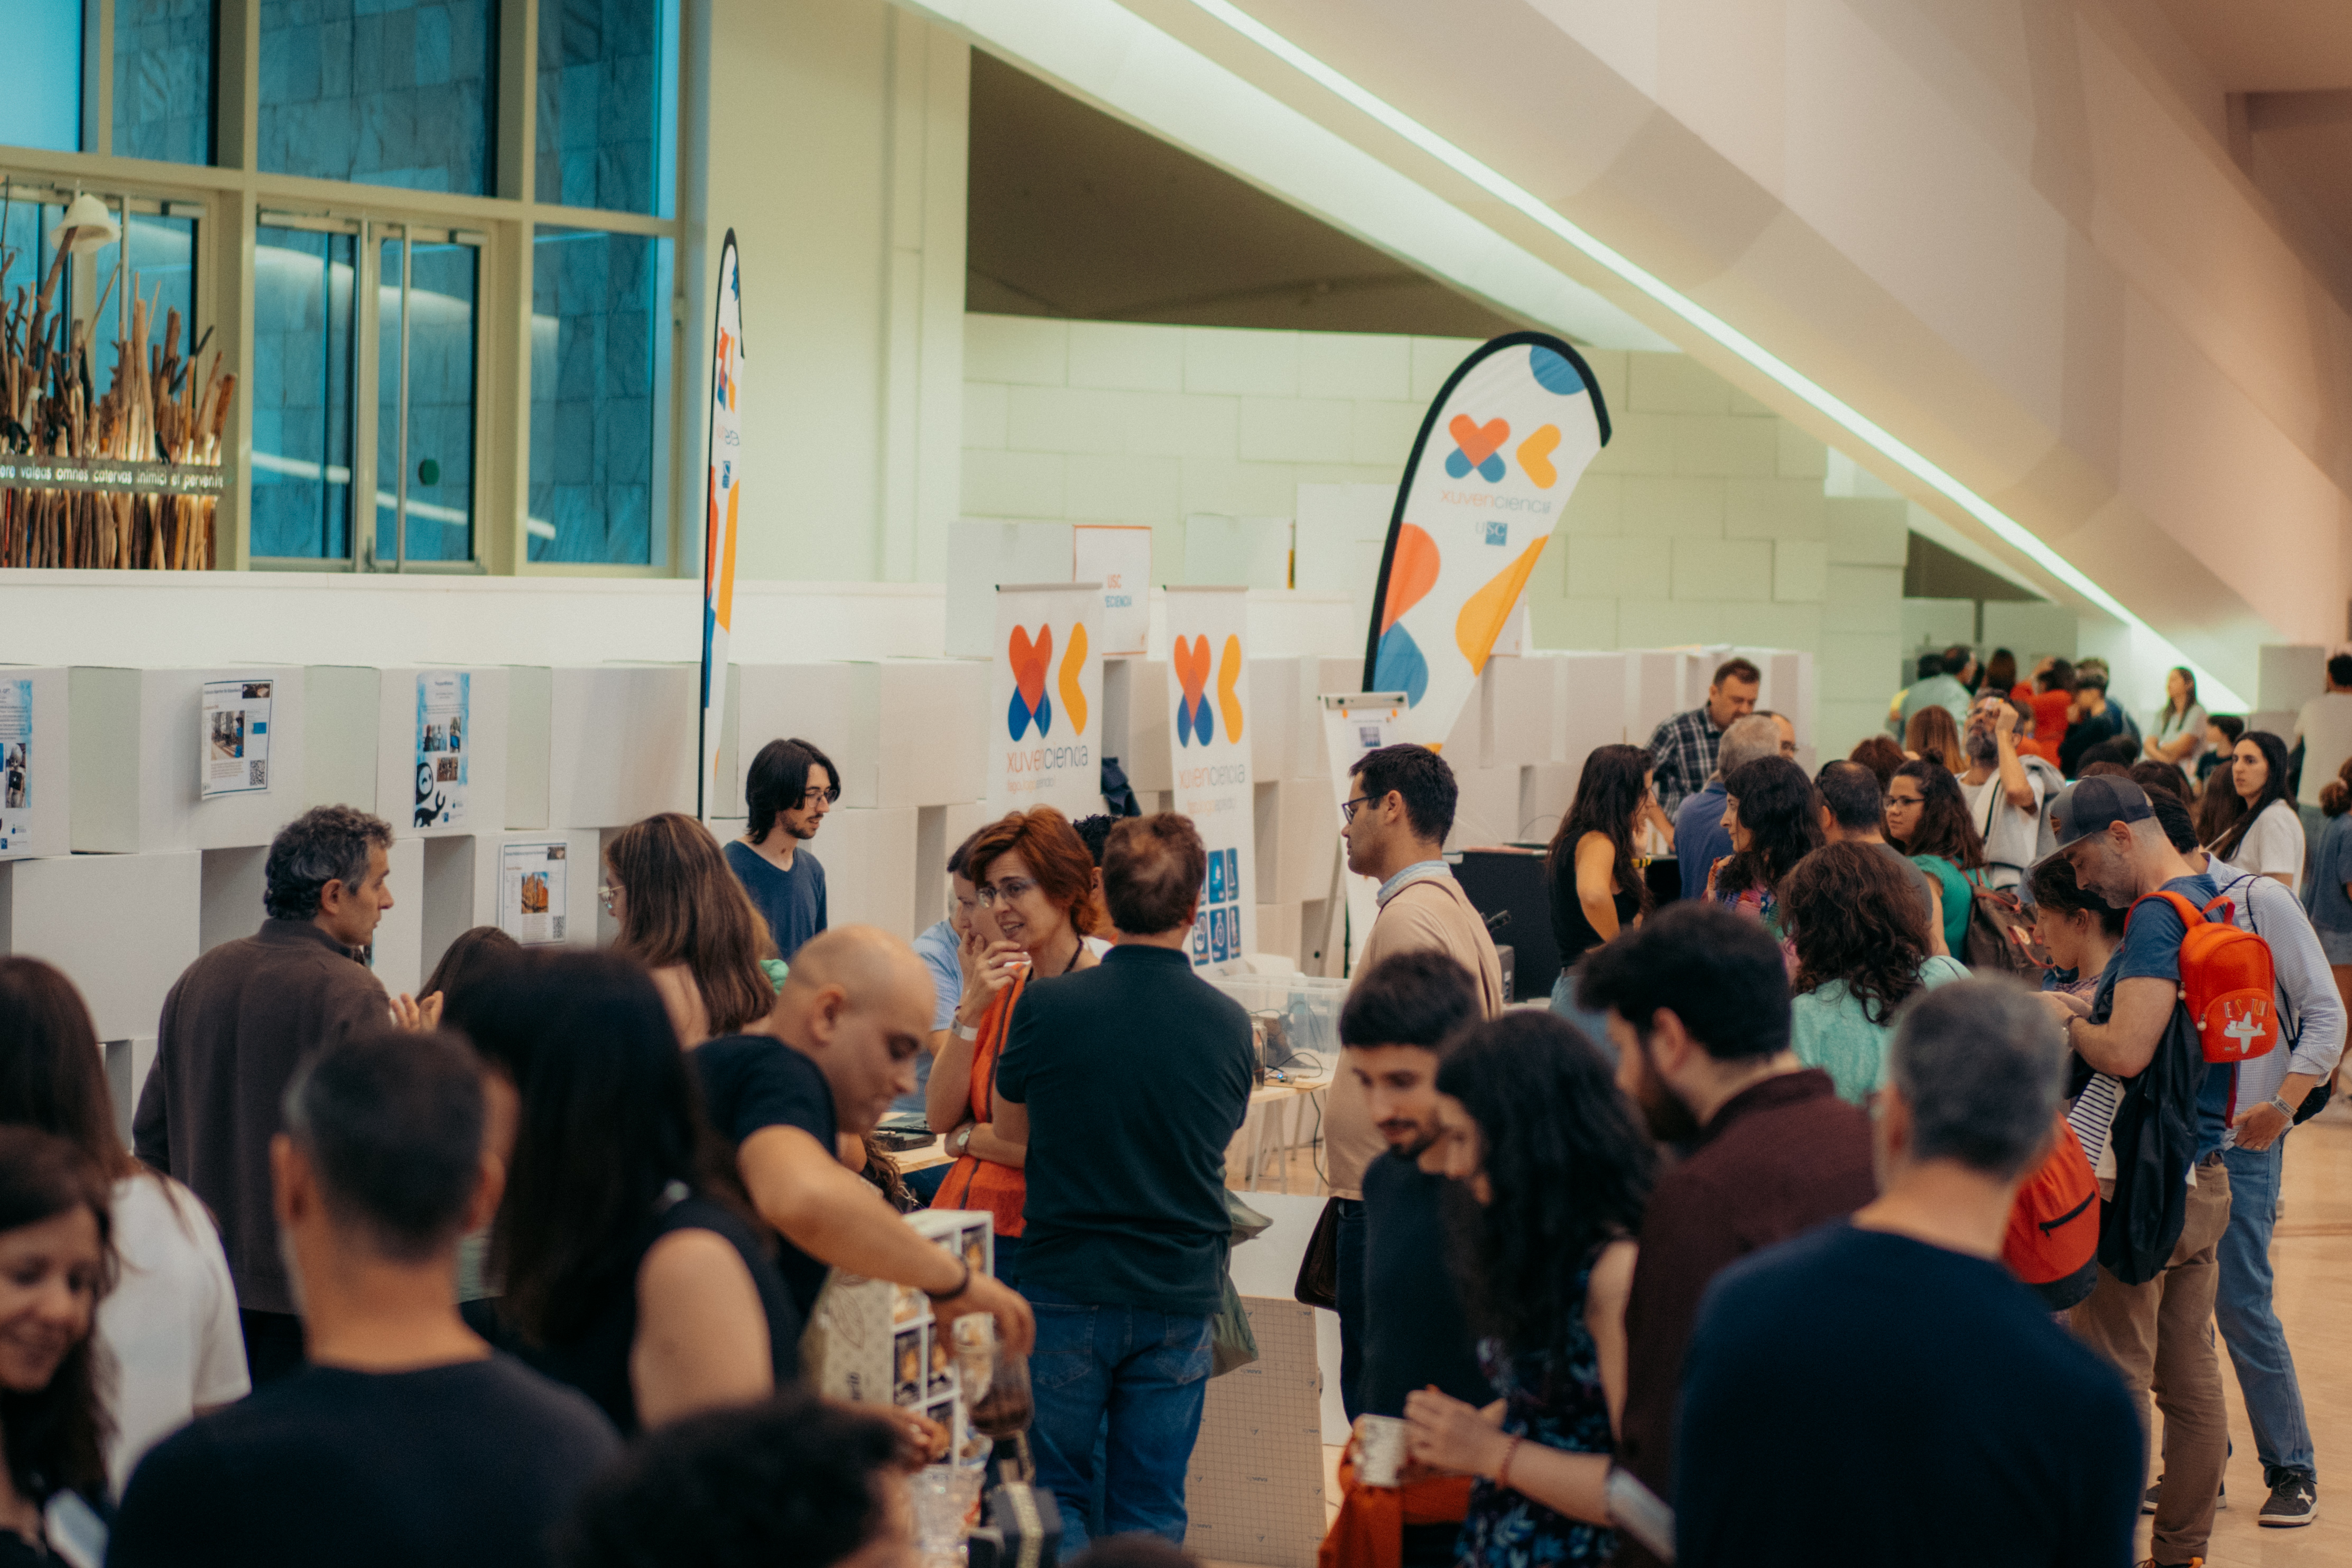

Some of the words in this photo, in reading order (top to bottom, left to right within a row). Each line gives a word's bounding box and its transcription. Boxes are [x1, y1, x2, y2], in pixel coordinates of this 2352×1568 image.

[55, 467, 89, 483] omnes
[1107, 573, 1122, 589] USC
[1007, 745, 1088, 773] xuvenciencia
